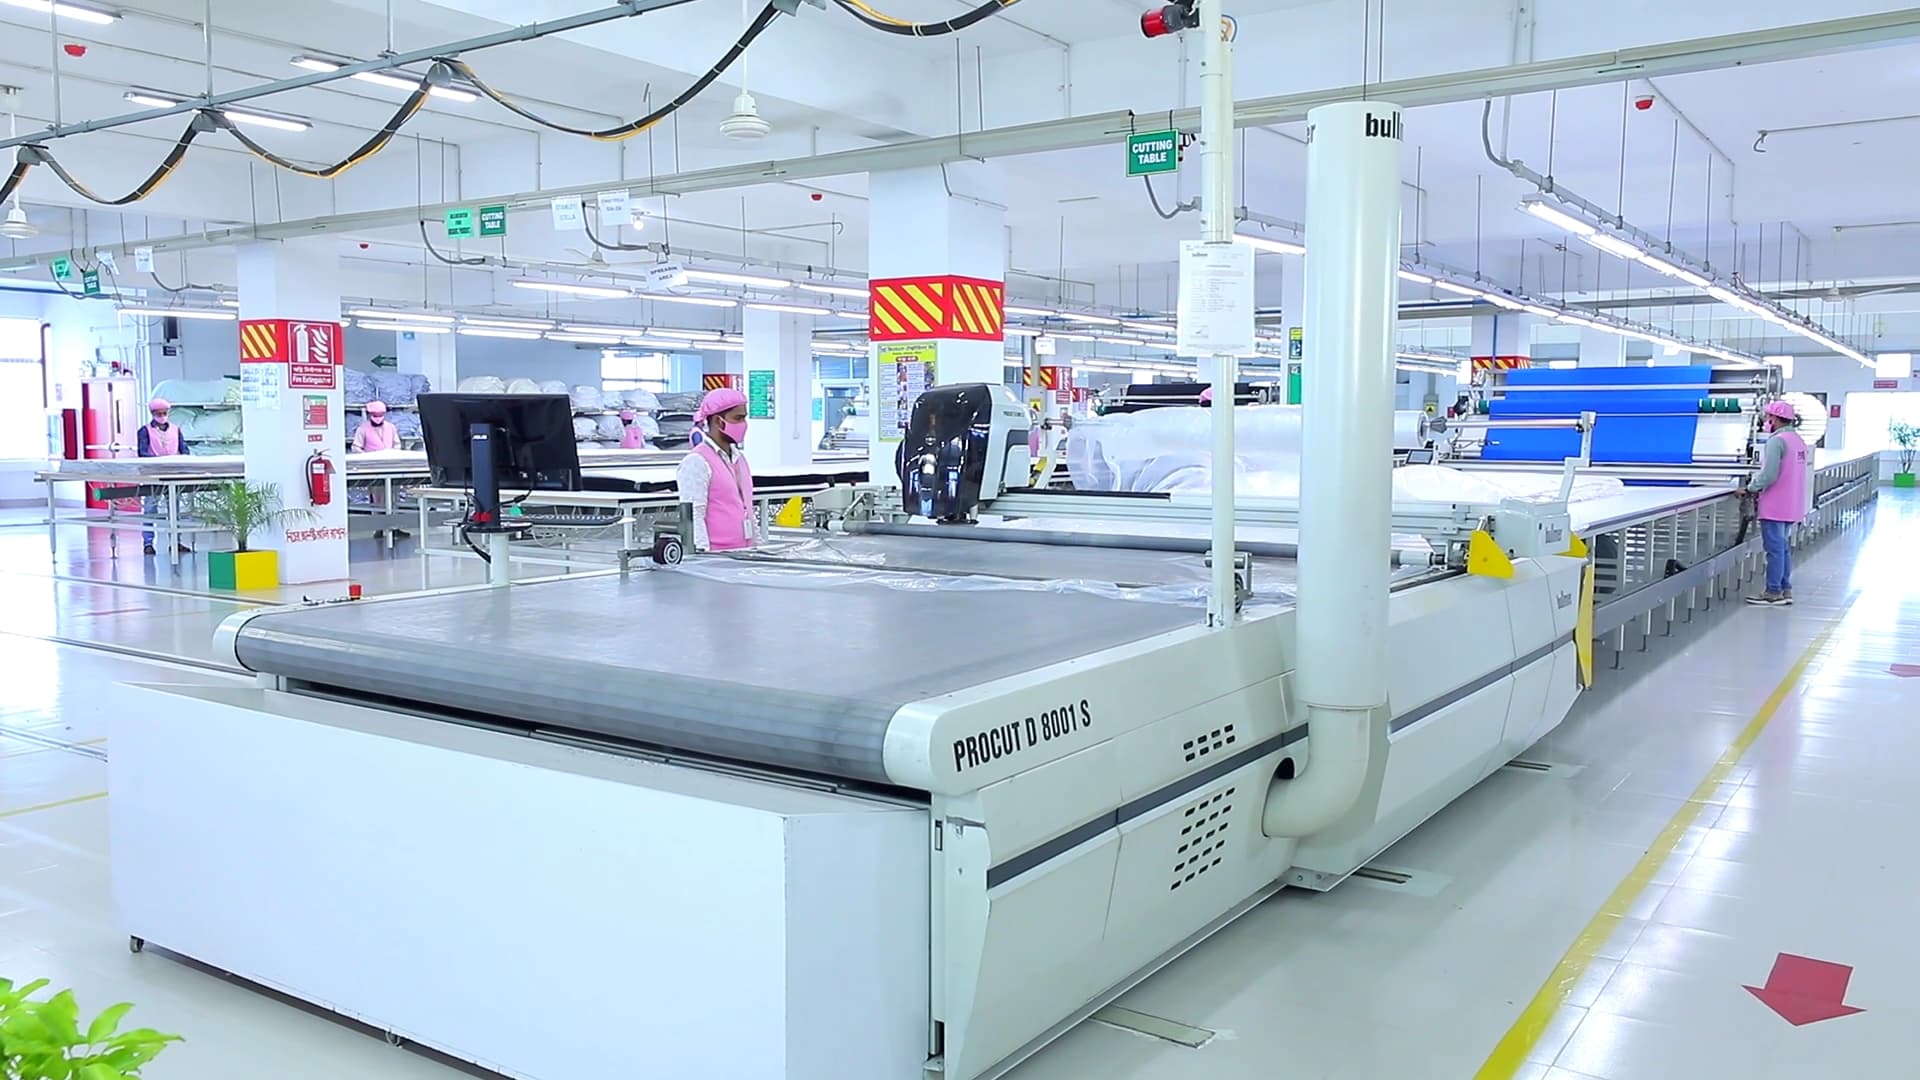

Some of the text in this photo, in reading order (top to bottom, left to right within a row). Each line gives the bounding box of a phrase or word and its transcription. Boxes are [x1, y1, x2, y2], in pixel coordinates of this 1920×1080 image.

[1132, 139, 1173, 154] CUTTING
[1138, 152, 1168, 165] TABLE
[953, 699, 1091, 772] PROCUT D 8001 S
